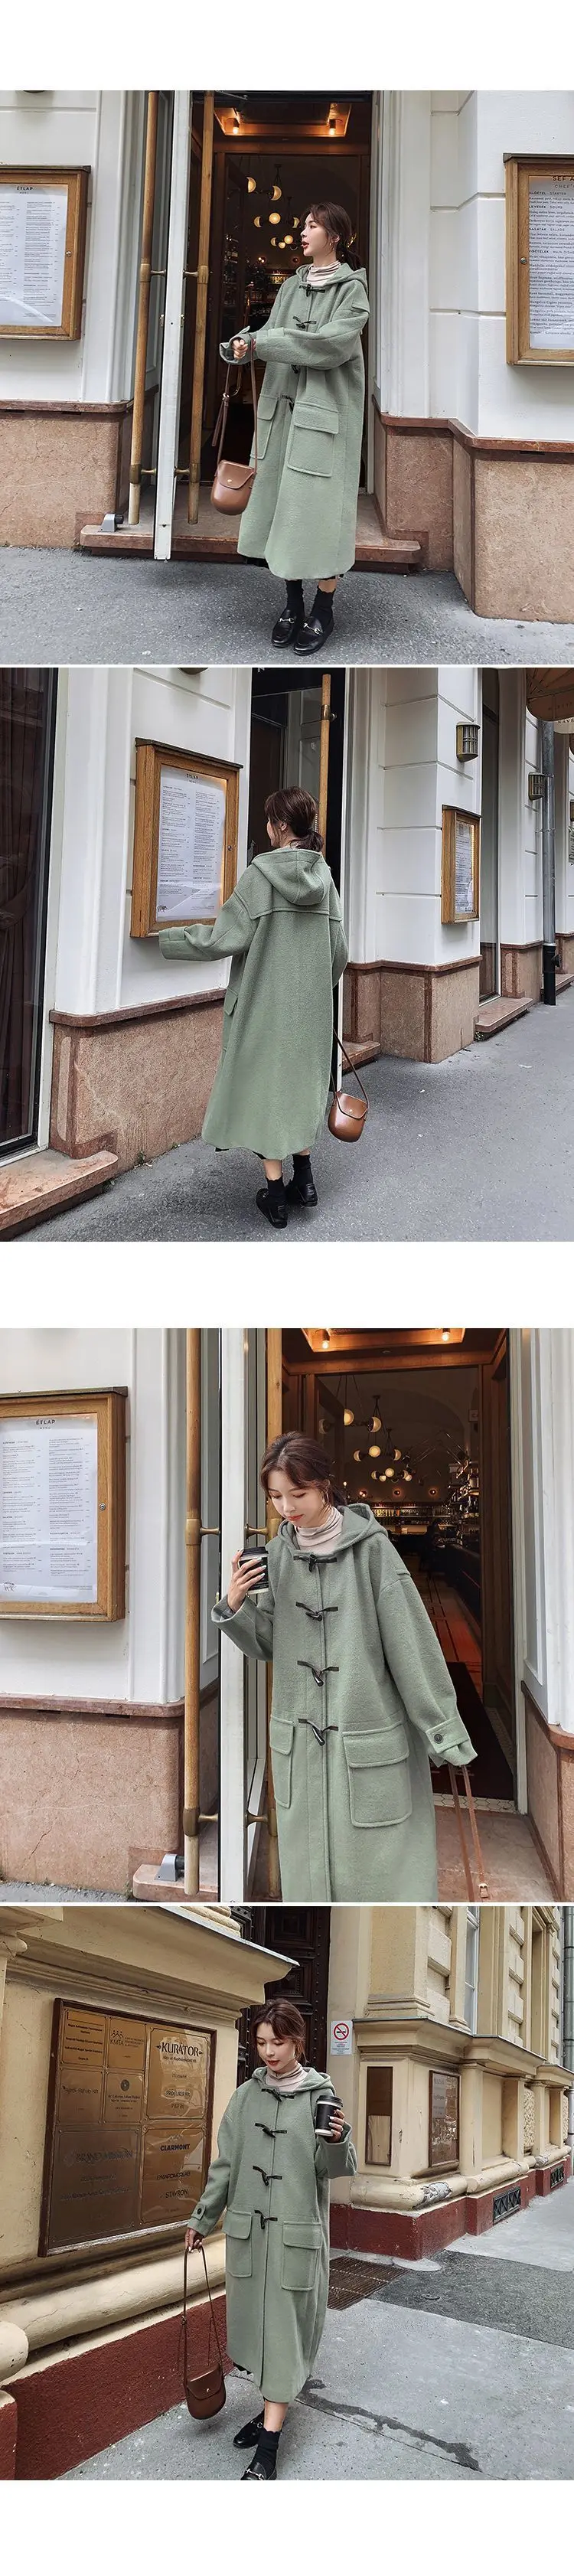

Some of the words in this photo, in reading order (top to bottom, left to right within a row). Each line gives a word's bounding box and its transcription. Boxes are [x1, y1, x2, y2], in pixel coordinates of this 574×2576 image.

[161, 2042, 200, 2057] KURÁTOR
[160, 2143, 191, 2152] CLARMONT
[165, 2189, 188, 2199] STAVRON
